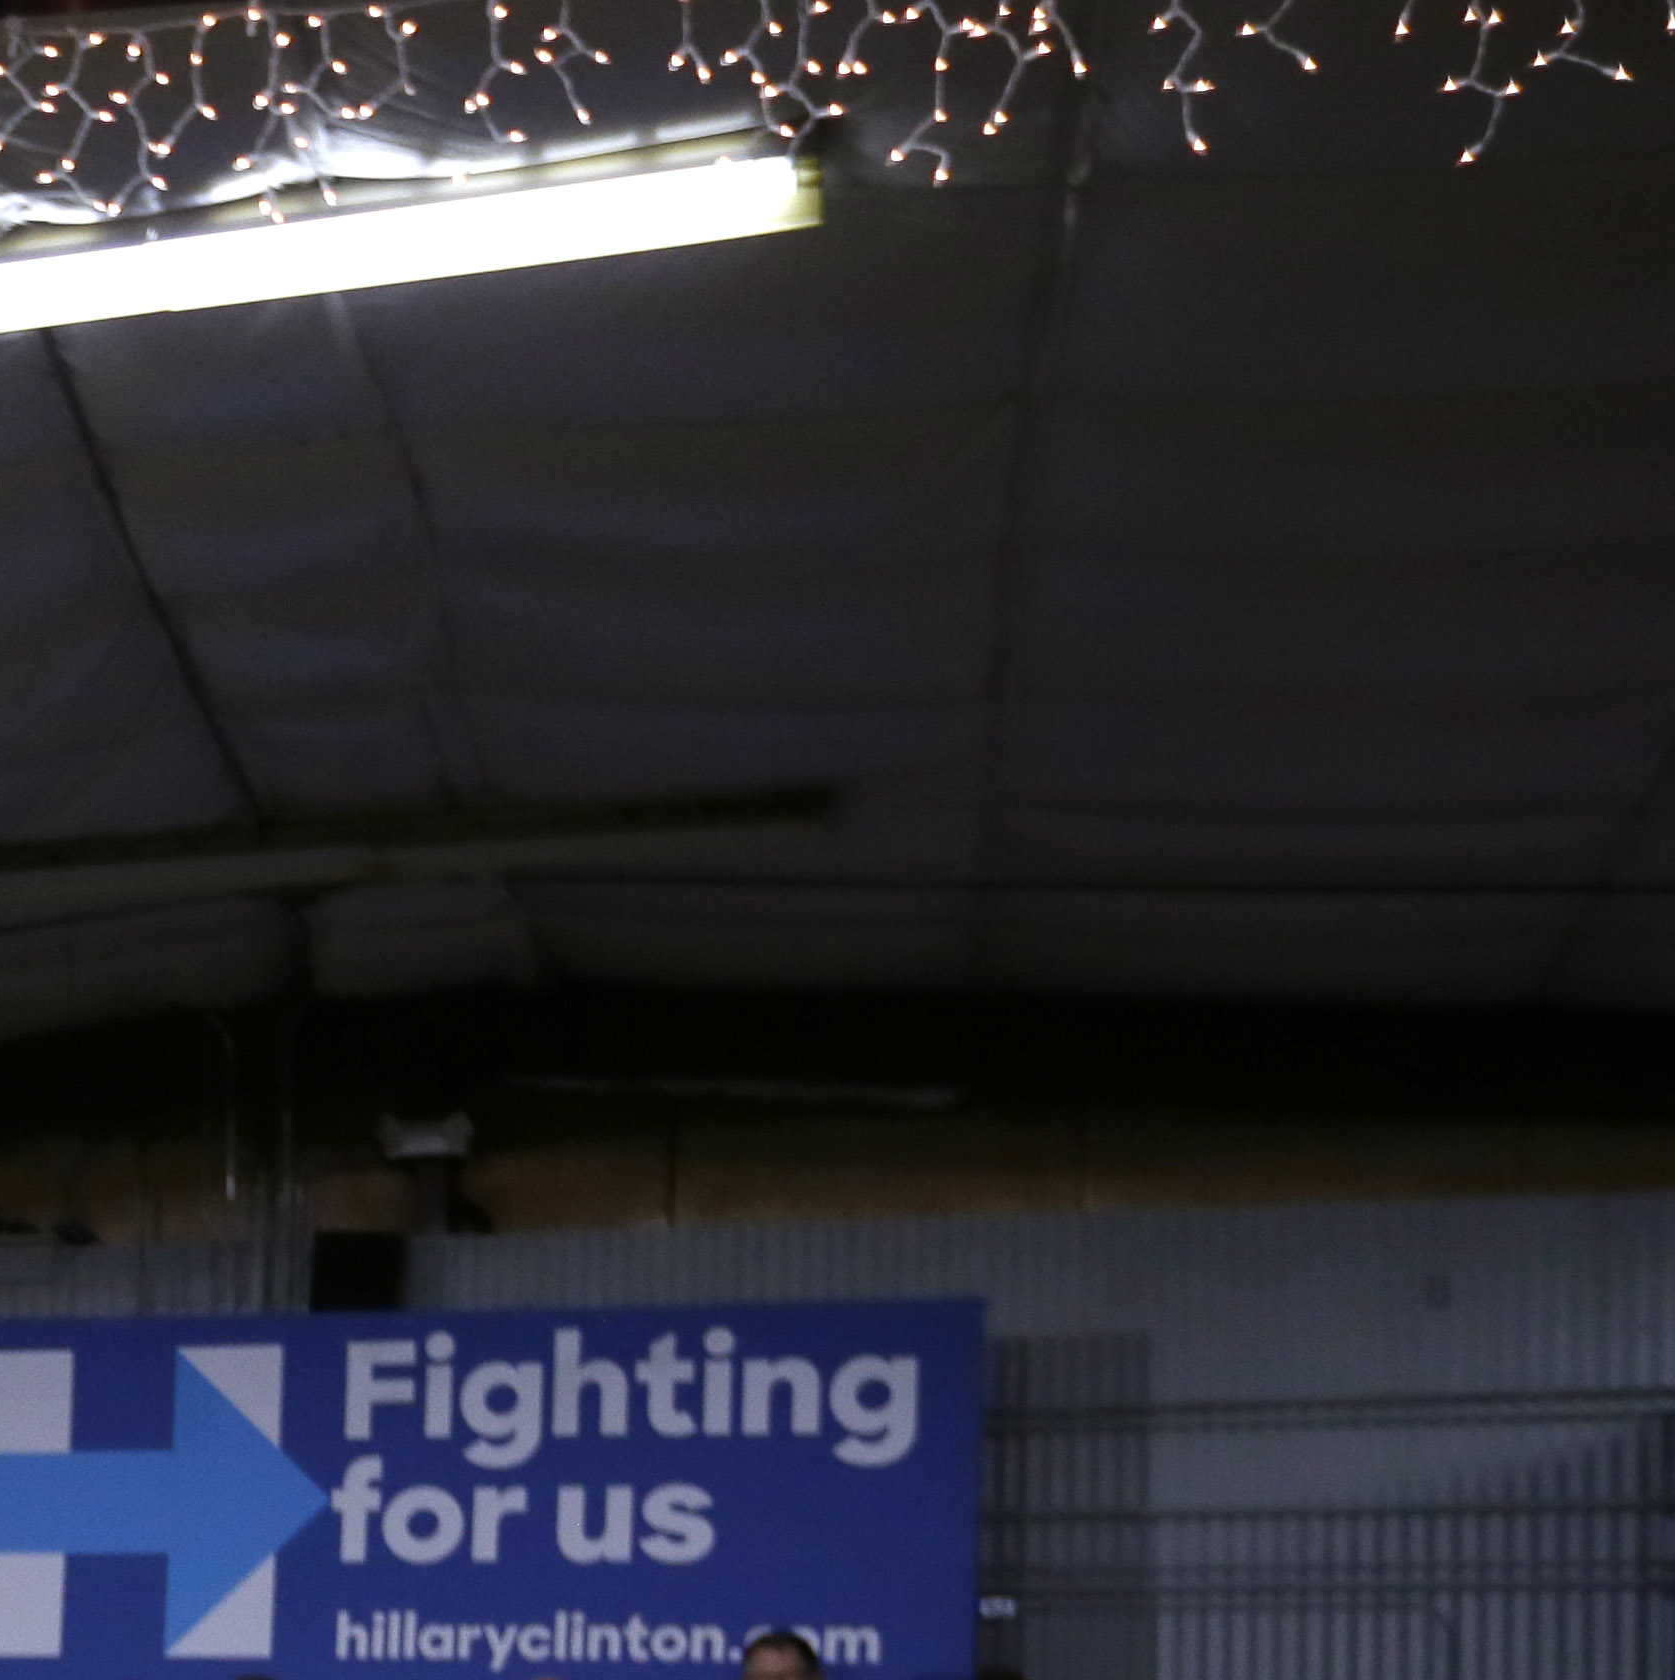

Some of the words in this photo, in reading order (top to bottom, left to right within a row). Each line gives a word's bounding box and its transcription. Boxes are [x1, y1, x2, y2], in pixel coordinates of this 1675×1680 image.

[344, 1328, 919, 1469] Fighting
[331, 1454, 527, 1563] for
[556, 1482, 715, 1565] us
[335, 1609, 882, 1674] hillaryclinton.m
